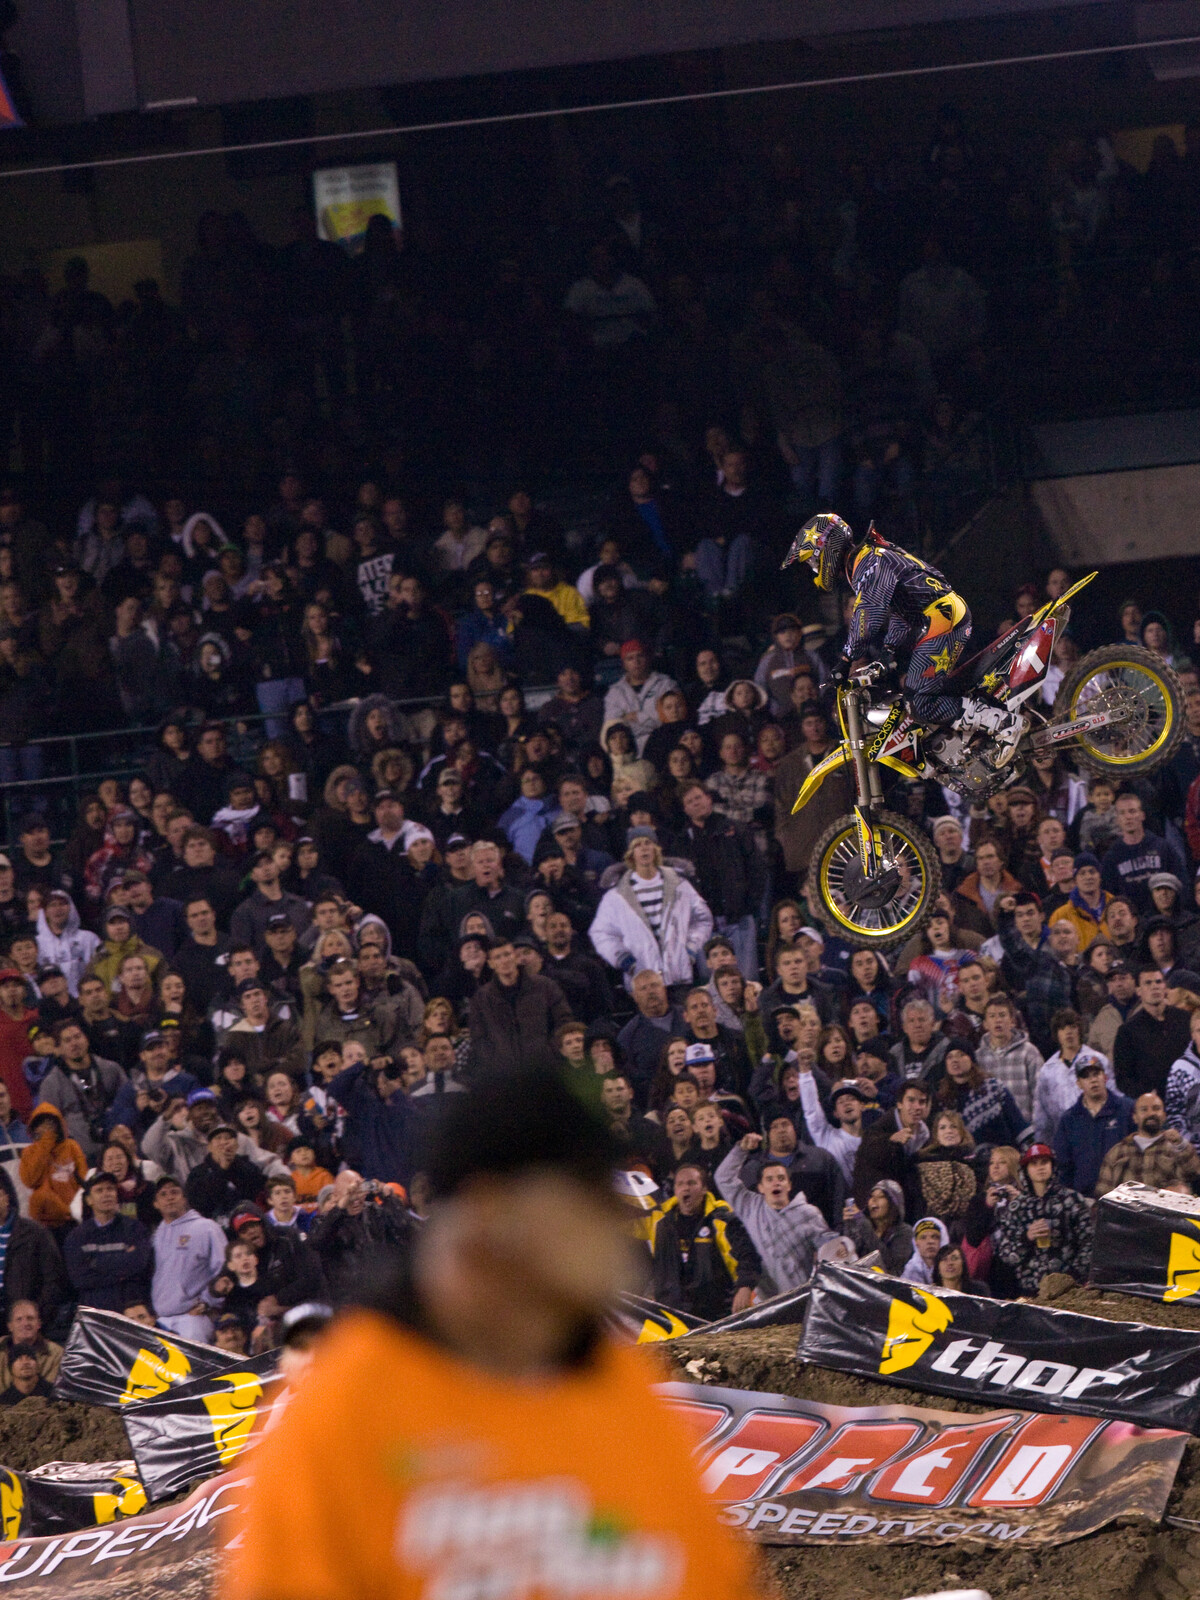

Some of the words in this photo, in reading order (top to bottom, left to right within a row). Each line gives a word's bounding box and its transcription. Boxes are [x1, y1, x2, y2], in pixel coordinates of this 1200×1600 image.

[996, 629, 1020, 650] SUZUKI
[1021, 644, 1045, 675] 1
[930, 1338, 1127, 1399] thor
